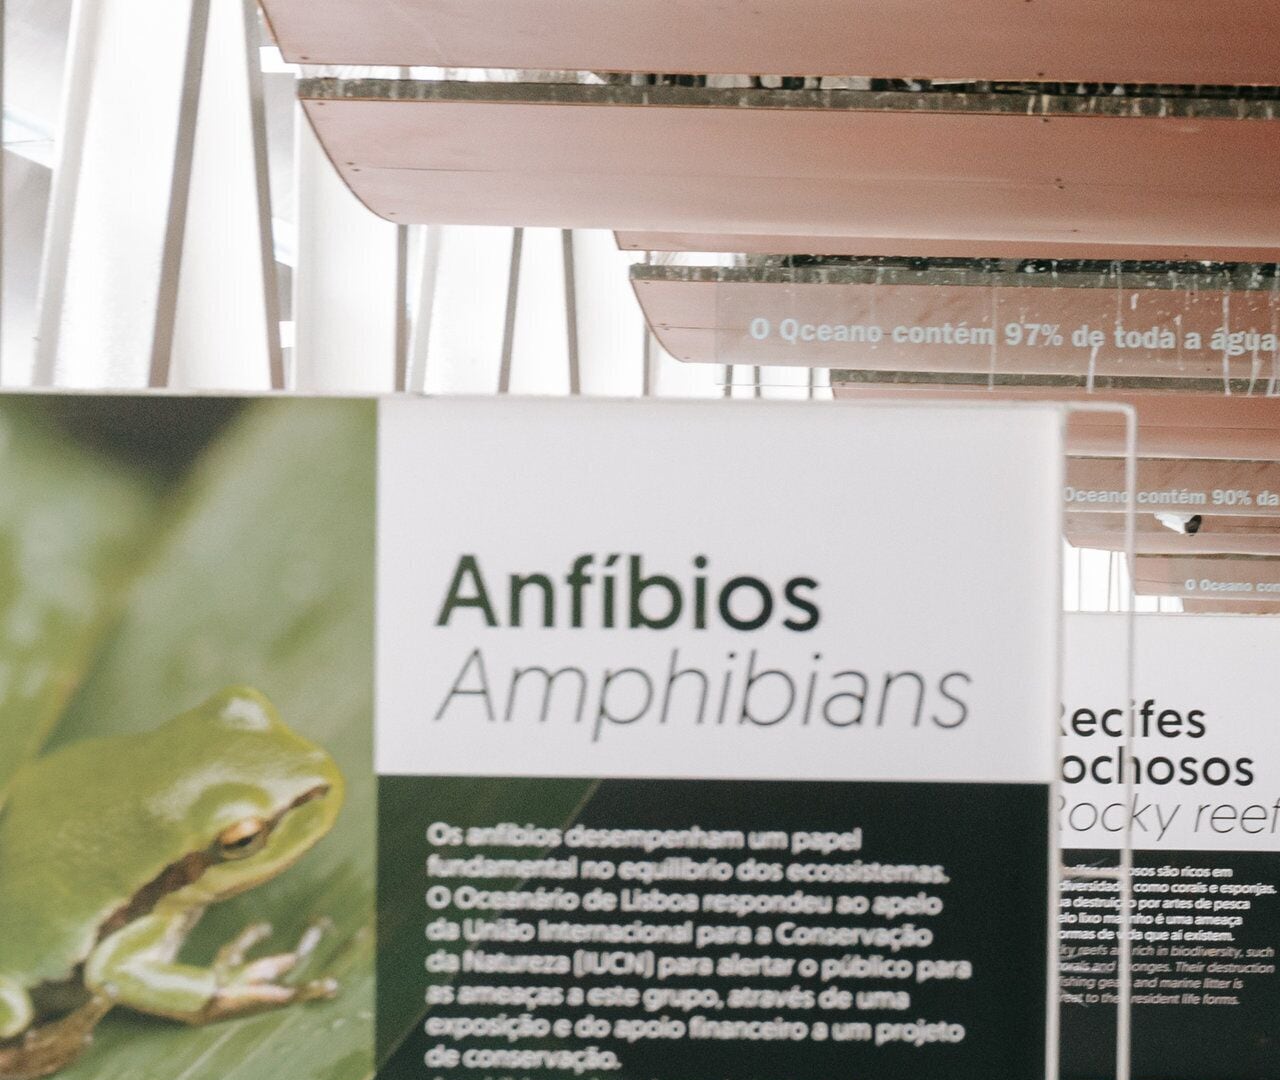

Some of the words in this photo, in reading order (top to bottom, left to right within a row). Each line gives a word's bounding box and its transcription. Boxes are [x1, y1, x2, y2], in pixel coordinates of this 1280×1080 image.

[749, 316, 770, 340] O
[892, 319, 997, 344] contém
[1004, 321, 1062, 346] 97%
[1071, 323, 1104, 347] de
[1114, 324, 1175, 349] toda
[1183, 331, 1201, 349] a
[1210, 326, 1280, 357] água
[1136, 487, 1206, 504] contém
[1211, 488, 1252, 505] 90%
[1256, 489, 1280, 506] da
[434, 554, 821, 632] Anfíbios
[434, 647, 972, 743] Amphibians
[1061, 746, 1254, 786] ochosos
[426, 824, 463, 847] Os
[465, 825, 562, 848] anfíbios
[565, 825, 744, 854] desempenham
[747, 832, 788, 849] um
[791, 826, 862, 855] papel
[426, 857, 577, 879] fundamental
[580, 863, 616, 879] no
[617, 858, 733, 885] equilíbrio
[735, 859, 783, 880] dos
[786, 859, 947, 881] ecossistemas.
[1156, 866, 1180, 877] são
[1180, 866, 1211, 877] ricos
[1211, 869, 1233, 877] em
[425, 888, 452, 909] O
[453, 888, 579, 910] Oceanário
[581, 889, 617, 911] de
[620, 889, 699, 911] Lisboa
[702, 890, 832, 917] respondeu
[835, 896, 869, 913] ao
[872, 891, 942, 918] apelo
[1132, 884, 1170, 893] como
[1170, 882, 1208, 893] corais
[1208, 885, 1219, 893] e
[1219, 885, 1276, 896] esponjas.
[1137, 900, 1160, 911] por
[1161, 898, 1193, 908] artes
[1193, 898, 1212, 909] de
[1213, 901, 1251, 911] pesca
[425, 920, 460, 942] da
[462, 920, 535, 942] União
[538, 920, 692, 943] Internacional
[695, 927, 752, 949] para
[754, 927, 773, 944] a
[775, 922, 932, 950] Conservação
[1153, 915, 1165, 925] é
[1165, 917, 1194, 925] uma
[1194, 917, 1243, 927] ameaça
[1143, 932, 1170, 942] que
[1183, 930, 1234, 940] existem.
